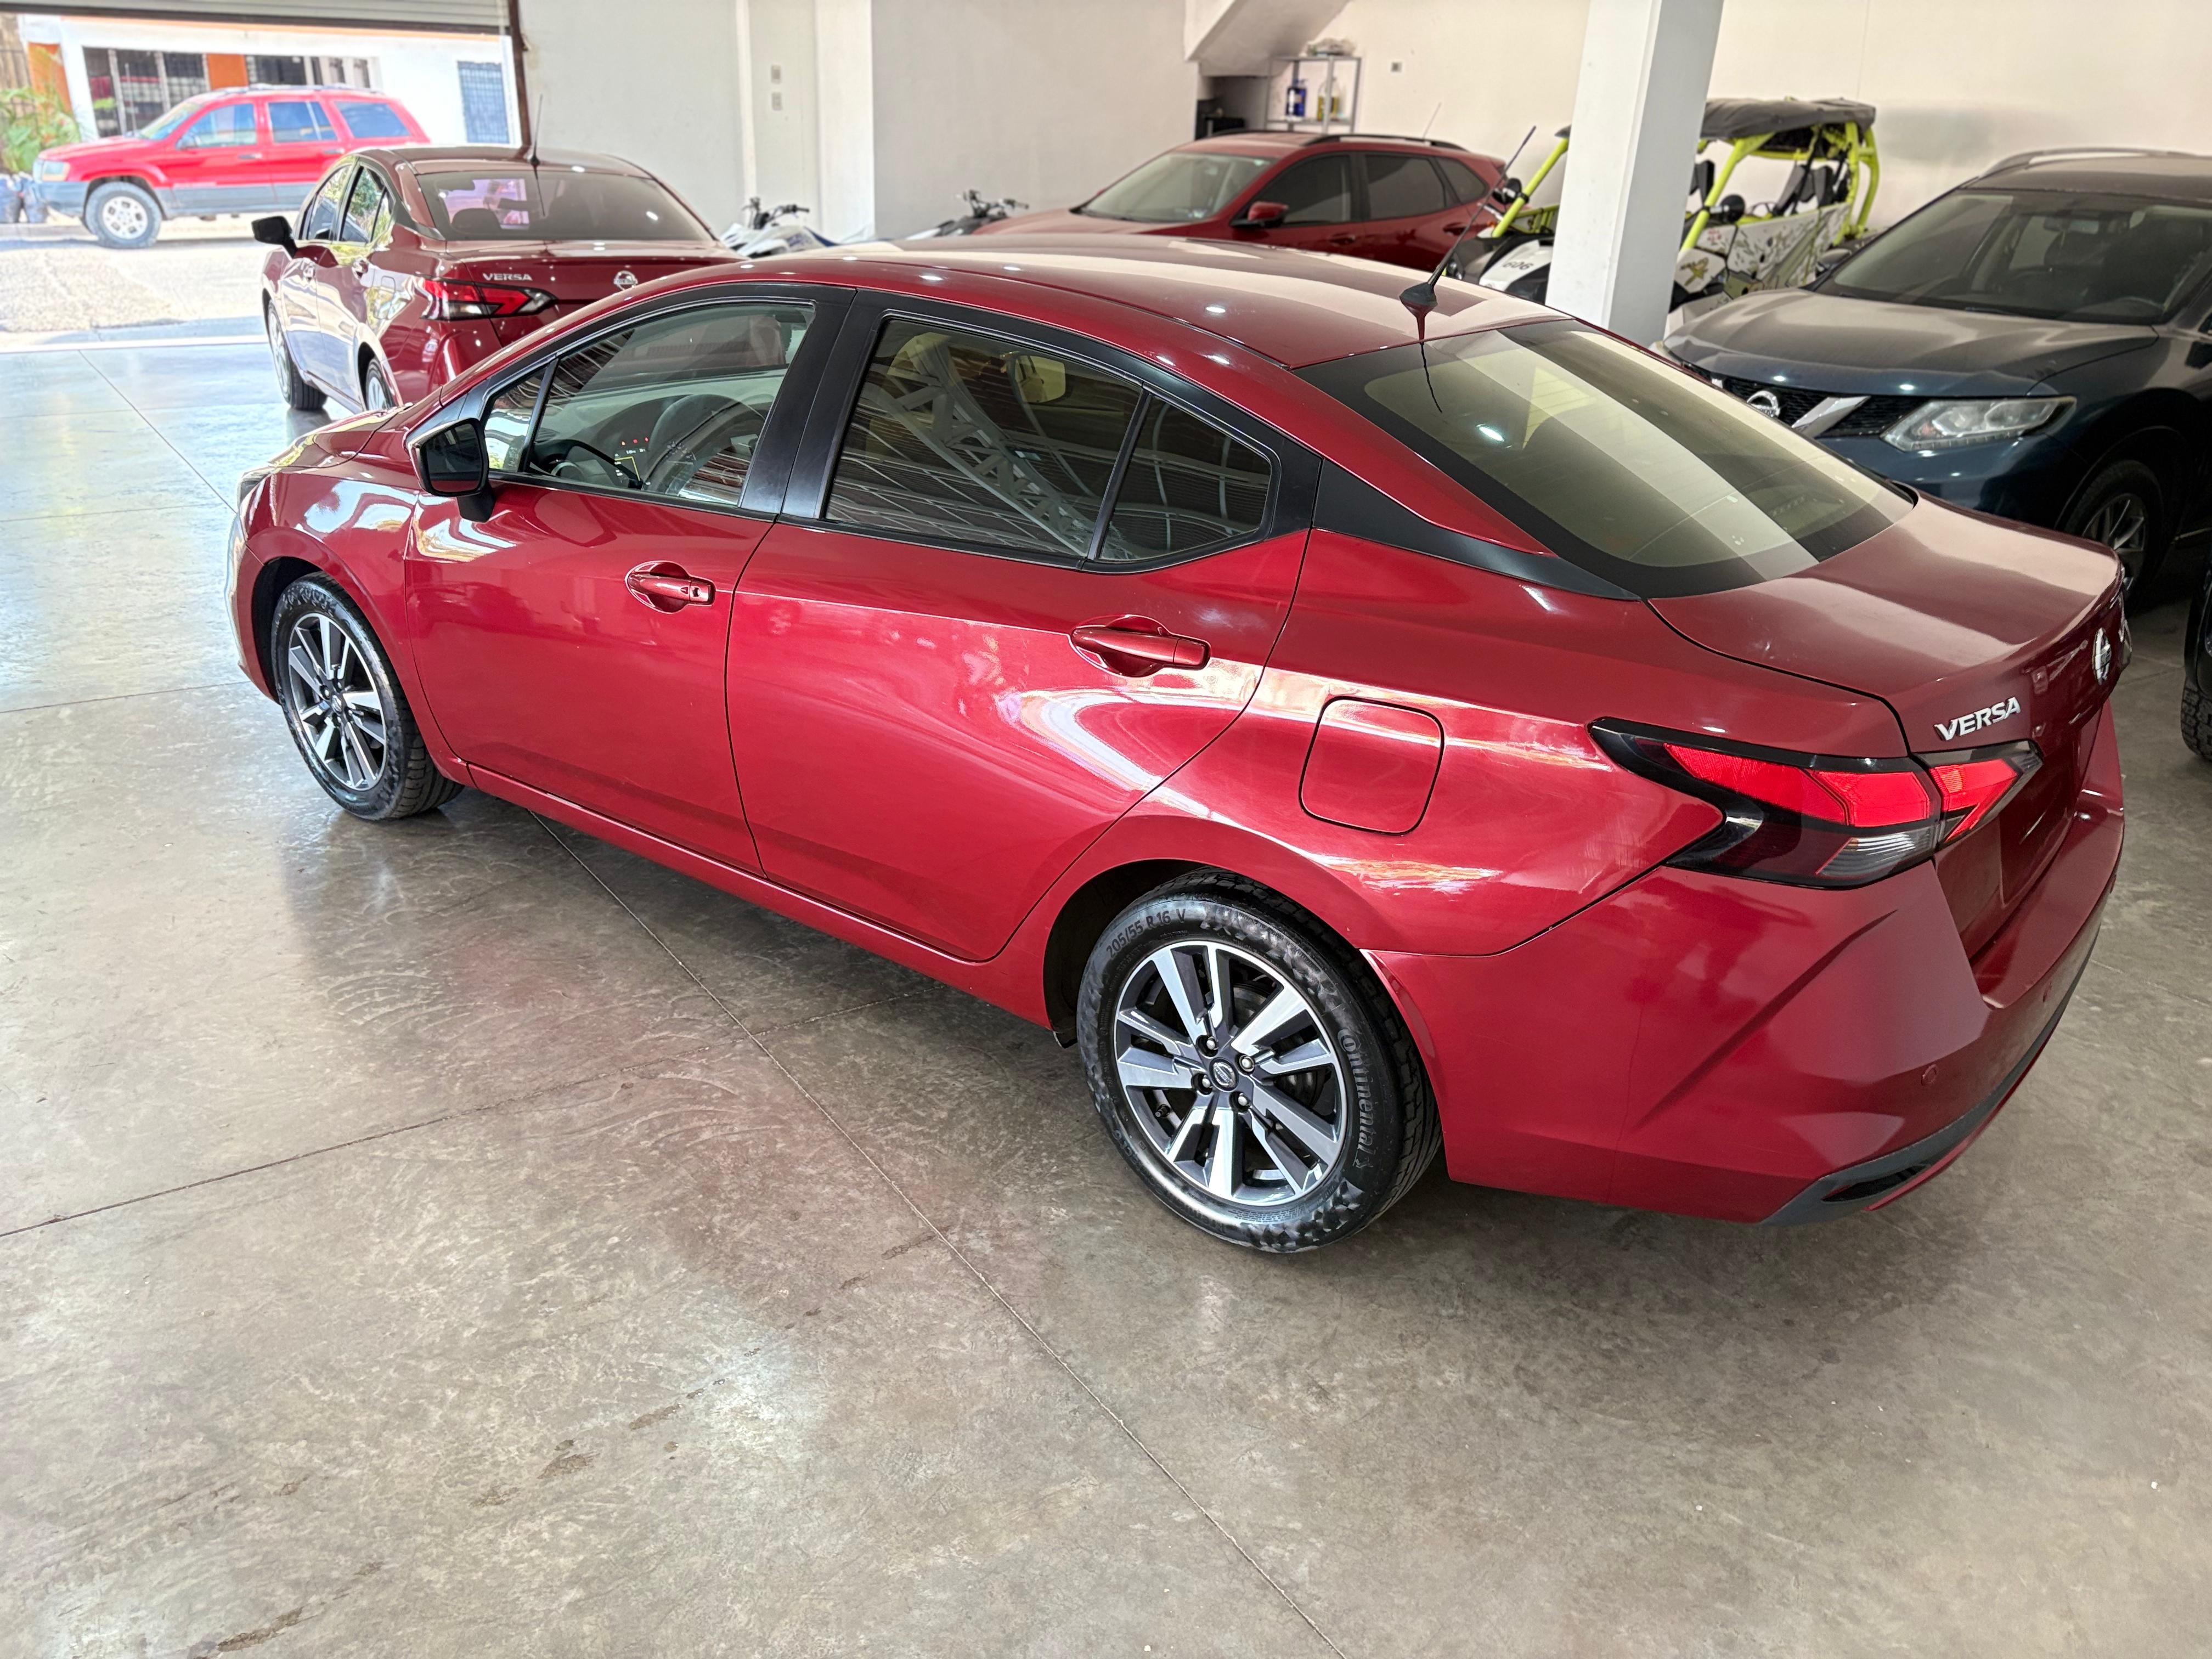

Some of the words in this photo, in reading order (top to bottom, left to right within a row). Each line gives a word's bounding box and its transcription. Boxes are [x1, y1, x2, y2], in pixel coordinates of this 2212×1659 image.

[1933, 697, 2021, 741] VERSA
[1106, 919, 1144, 958] 205/55
[1176, 908, 1186, 923] V
[1337, 1028, 1376, 1155] Continental
